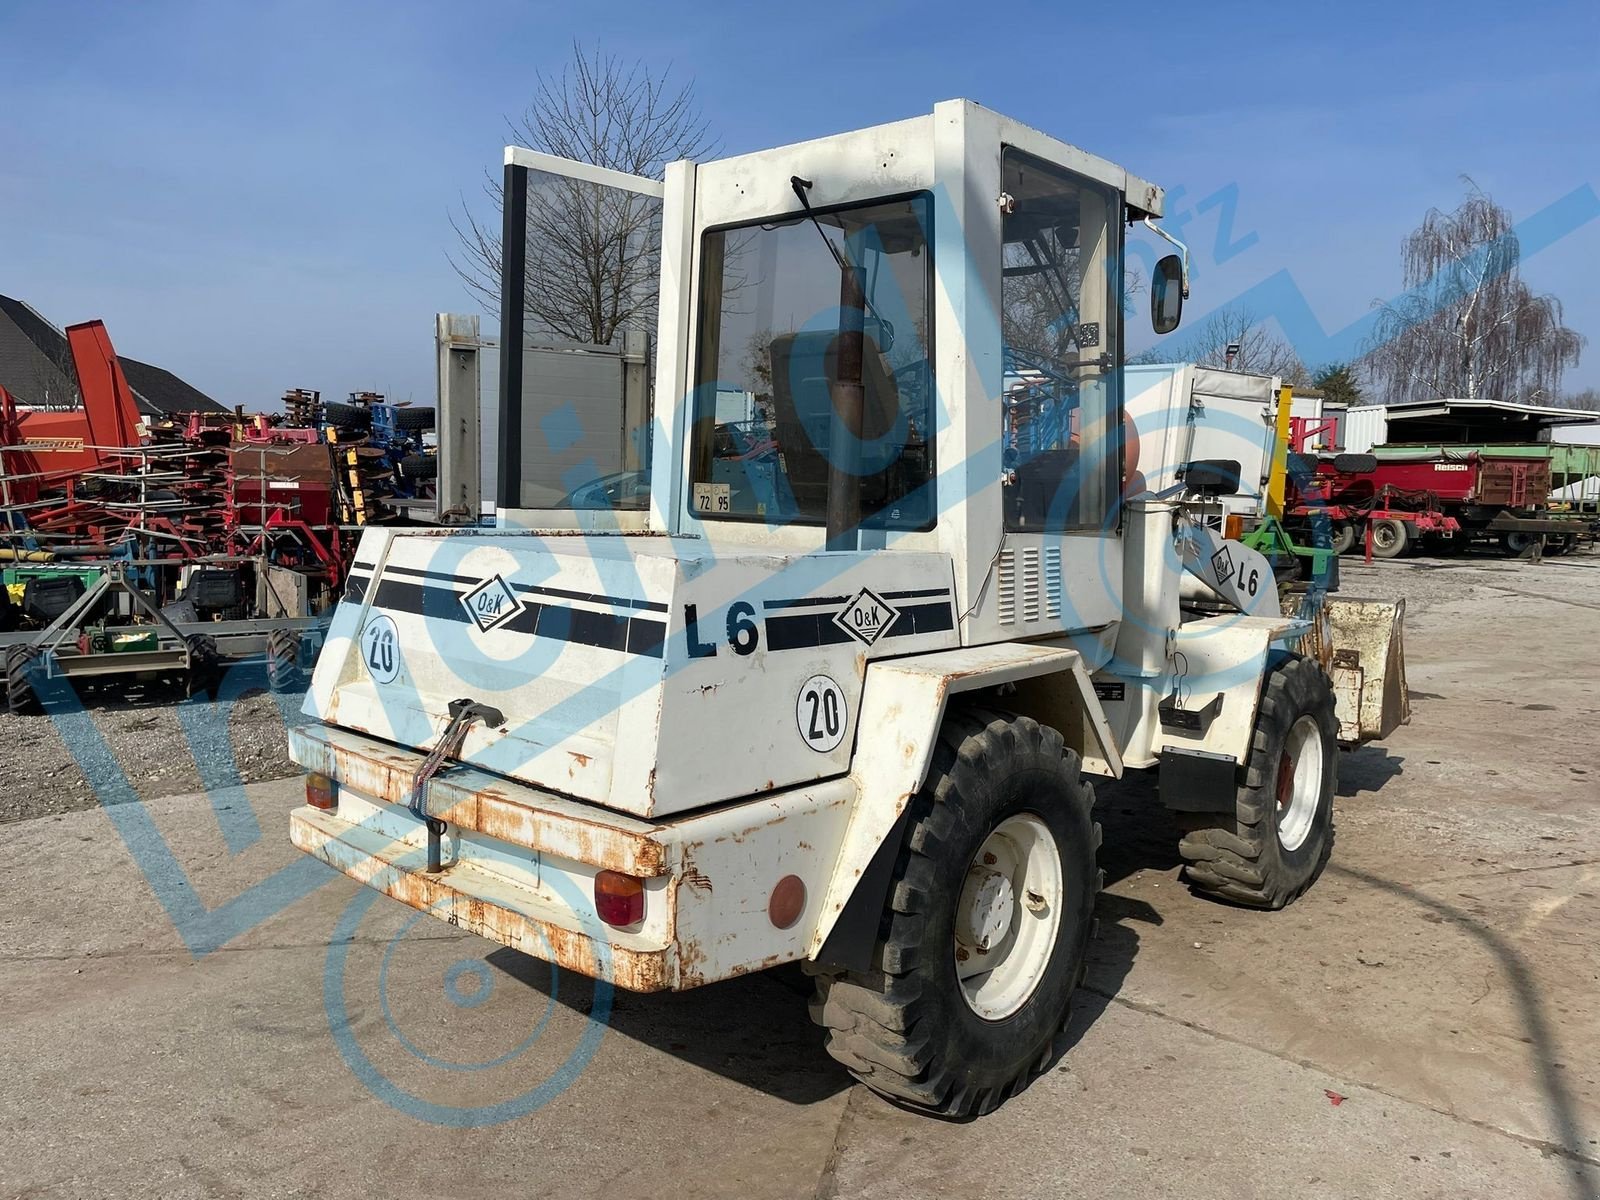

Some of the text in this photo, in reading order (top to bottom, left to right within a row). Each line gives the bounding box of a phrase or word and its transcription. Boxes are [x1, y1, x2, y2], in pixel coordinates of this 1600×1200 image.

[700, 495, 710, 510] 72
[718, 496, 729, 511] 95
[477, 592, 505, 615] O&K
[854, 605, 881, 628] O&K
[369, 626, 393, 673] 20
[805, 688, 840, 740] 20
